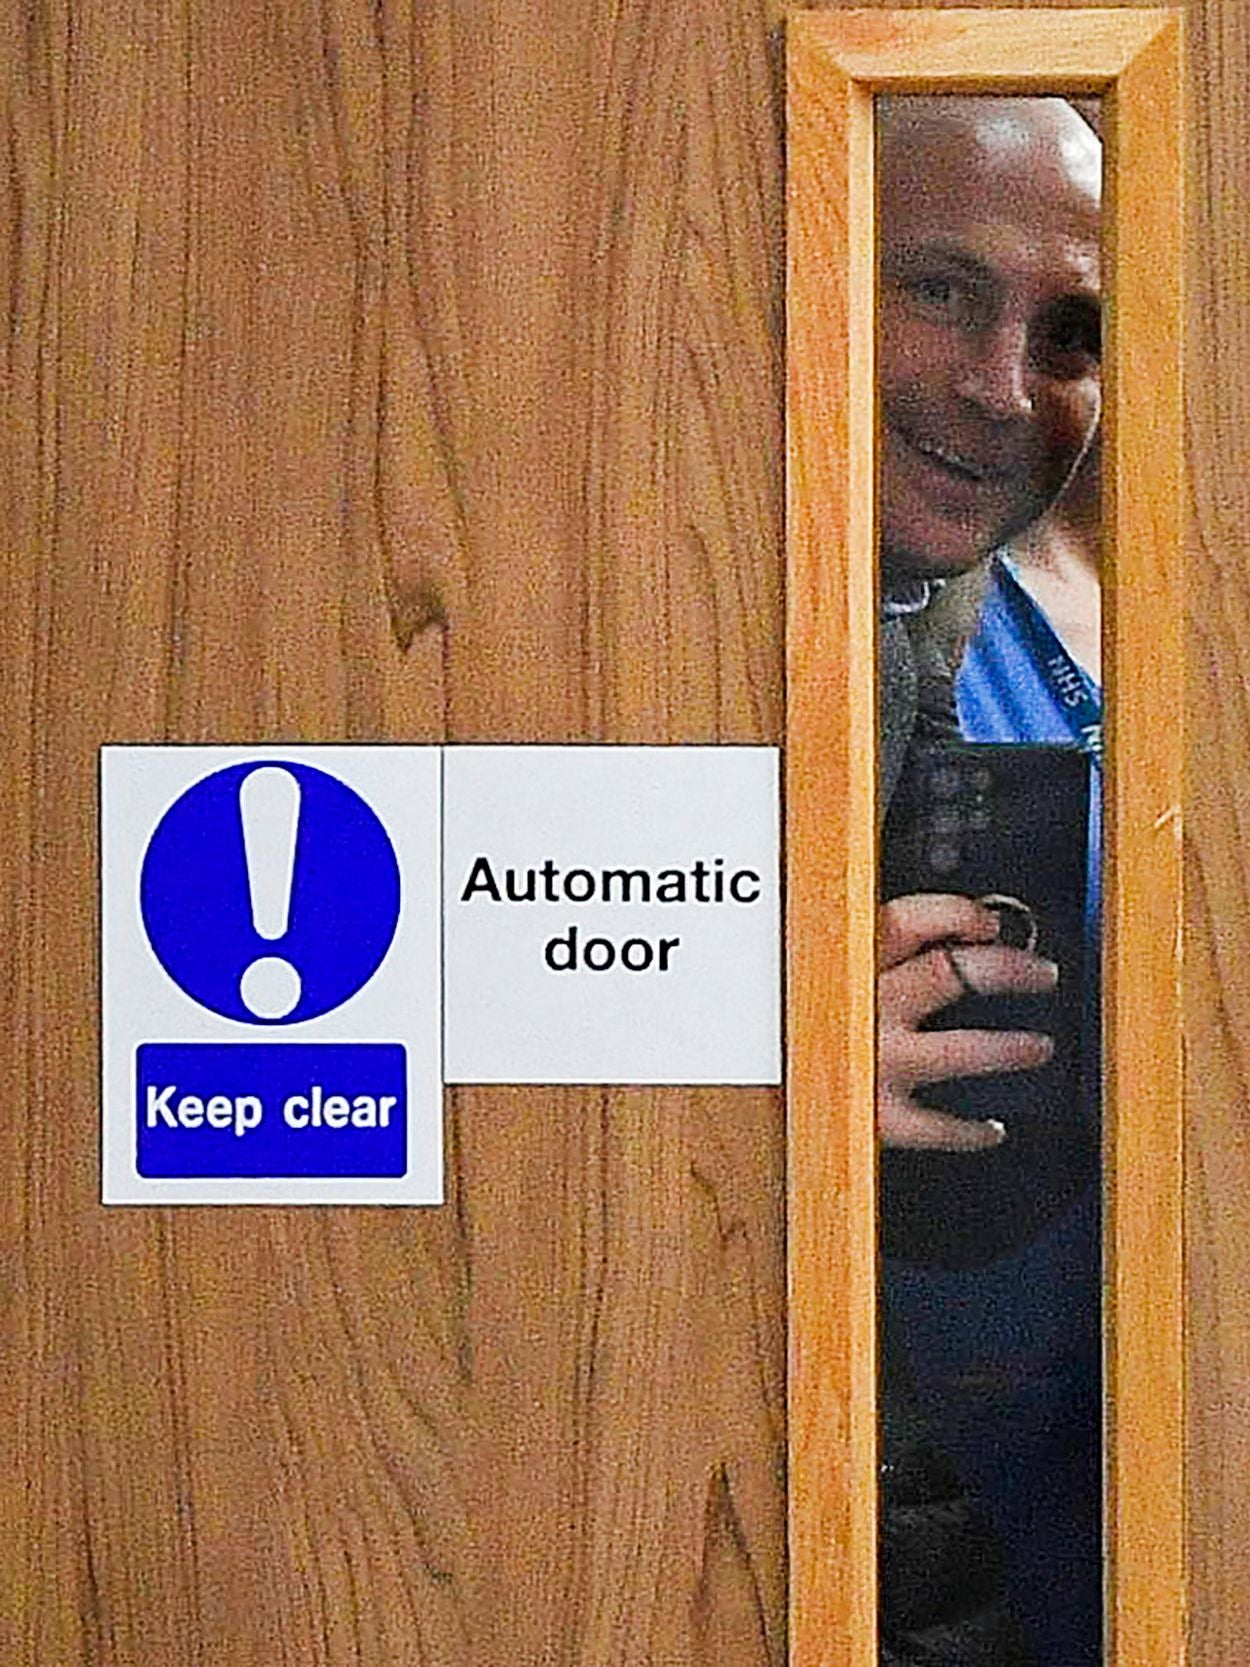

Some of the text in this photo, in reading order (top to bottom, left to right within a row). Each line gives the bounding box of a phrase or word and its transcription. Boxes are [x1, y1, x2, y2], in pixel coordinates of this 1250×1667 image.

[1047, 653, 1089, 708] NHS
[460, 857, 761, 904] Automatic
[544, 925, 680, 973] door
[145, 1084, 398, 1138] Keep clear
